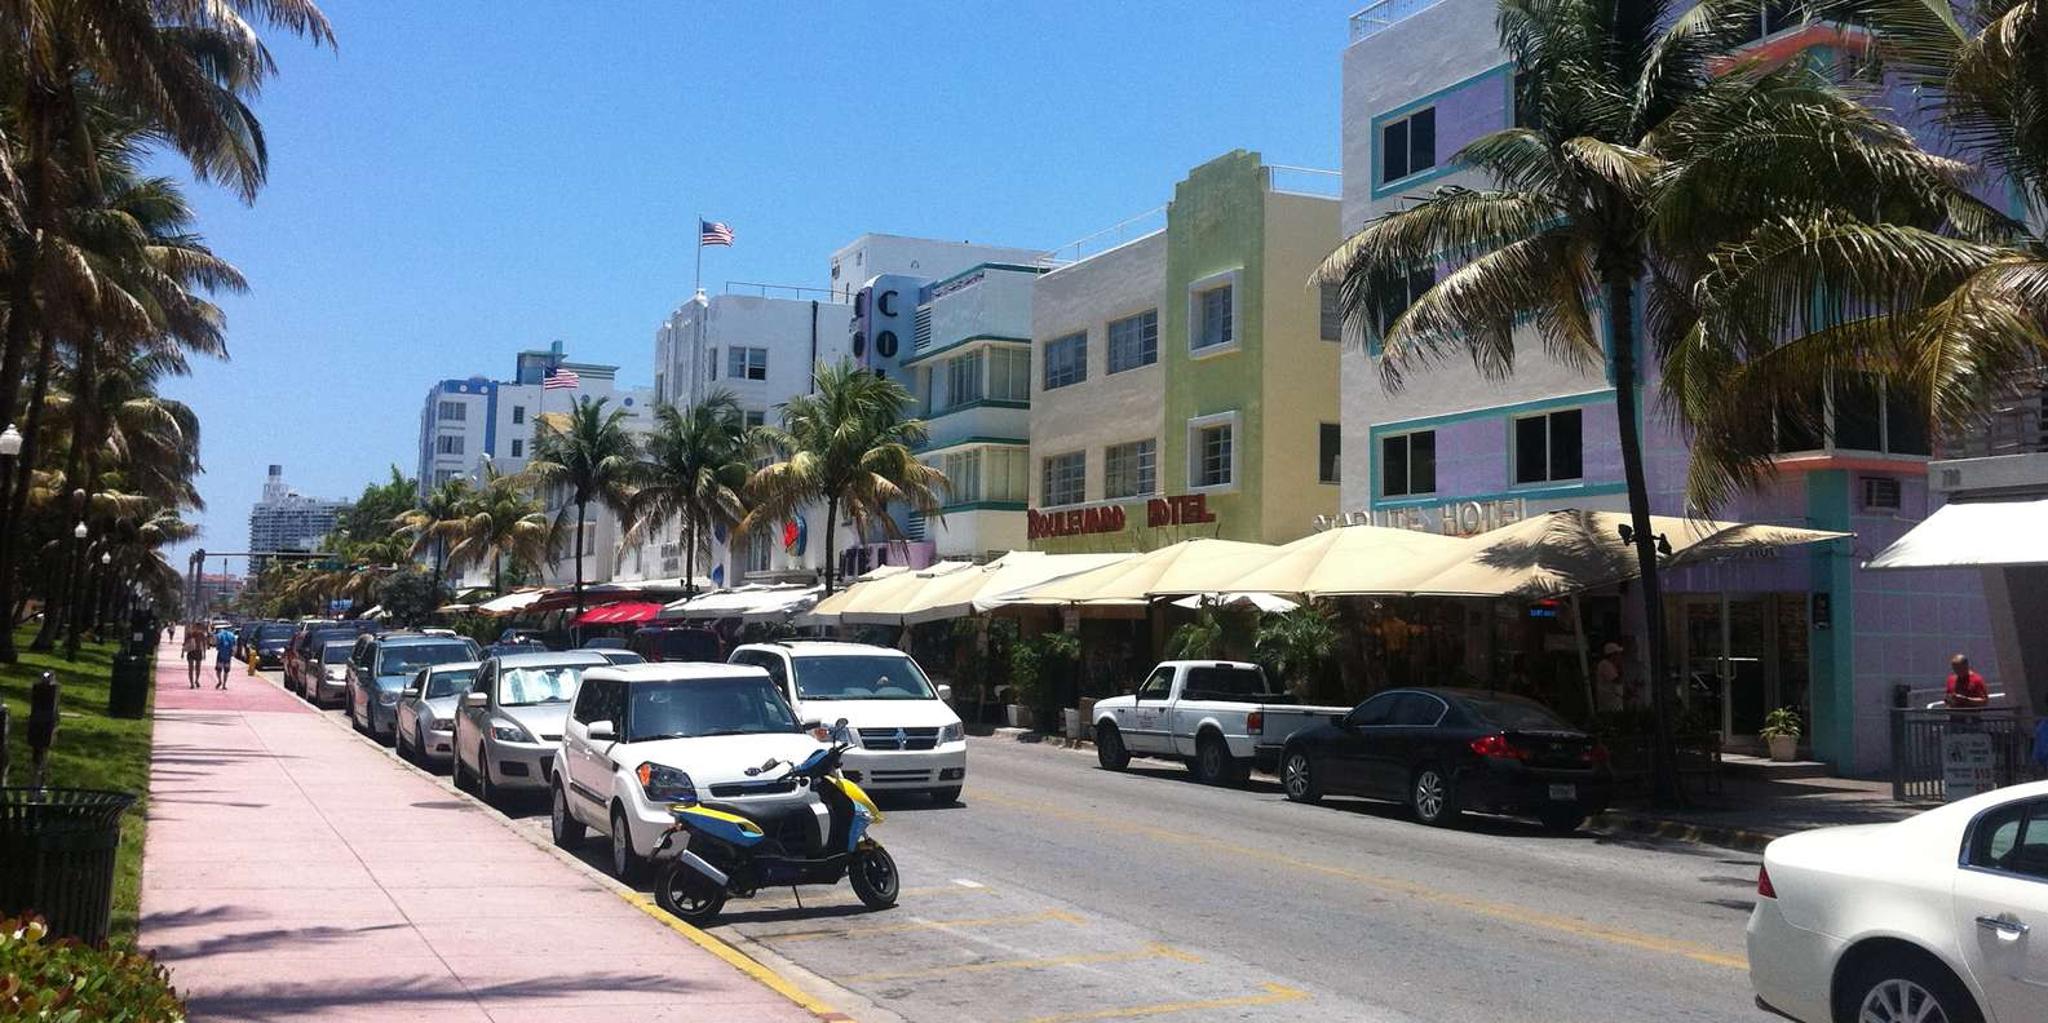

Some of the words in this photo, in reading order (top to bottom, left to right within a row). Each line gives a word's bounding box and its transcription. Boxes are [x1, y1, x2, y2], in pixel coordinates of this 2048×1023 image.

[876, 290, 898, 378] CO
[1027, 507, 1125, 540] BOULEVARD
[1147, 493, 1216, 528] HOTEL
